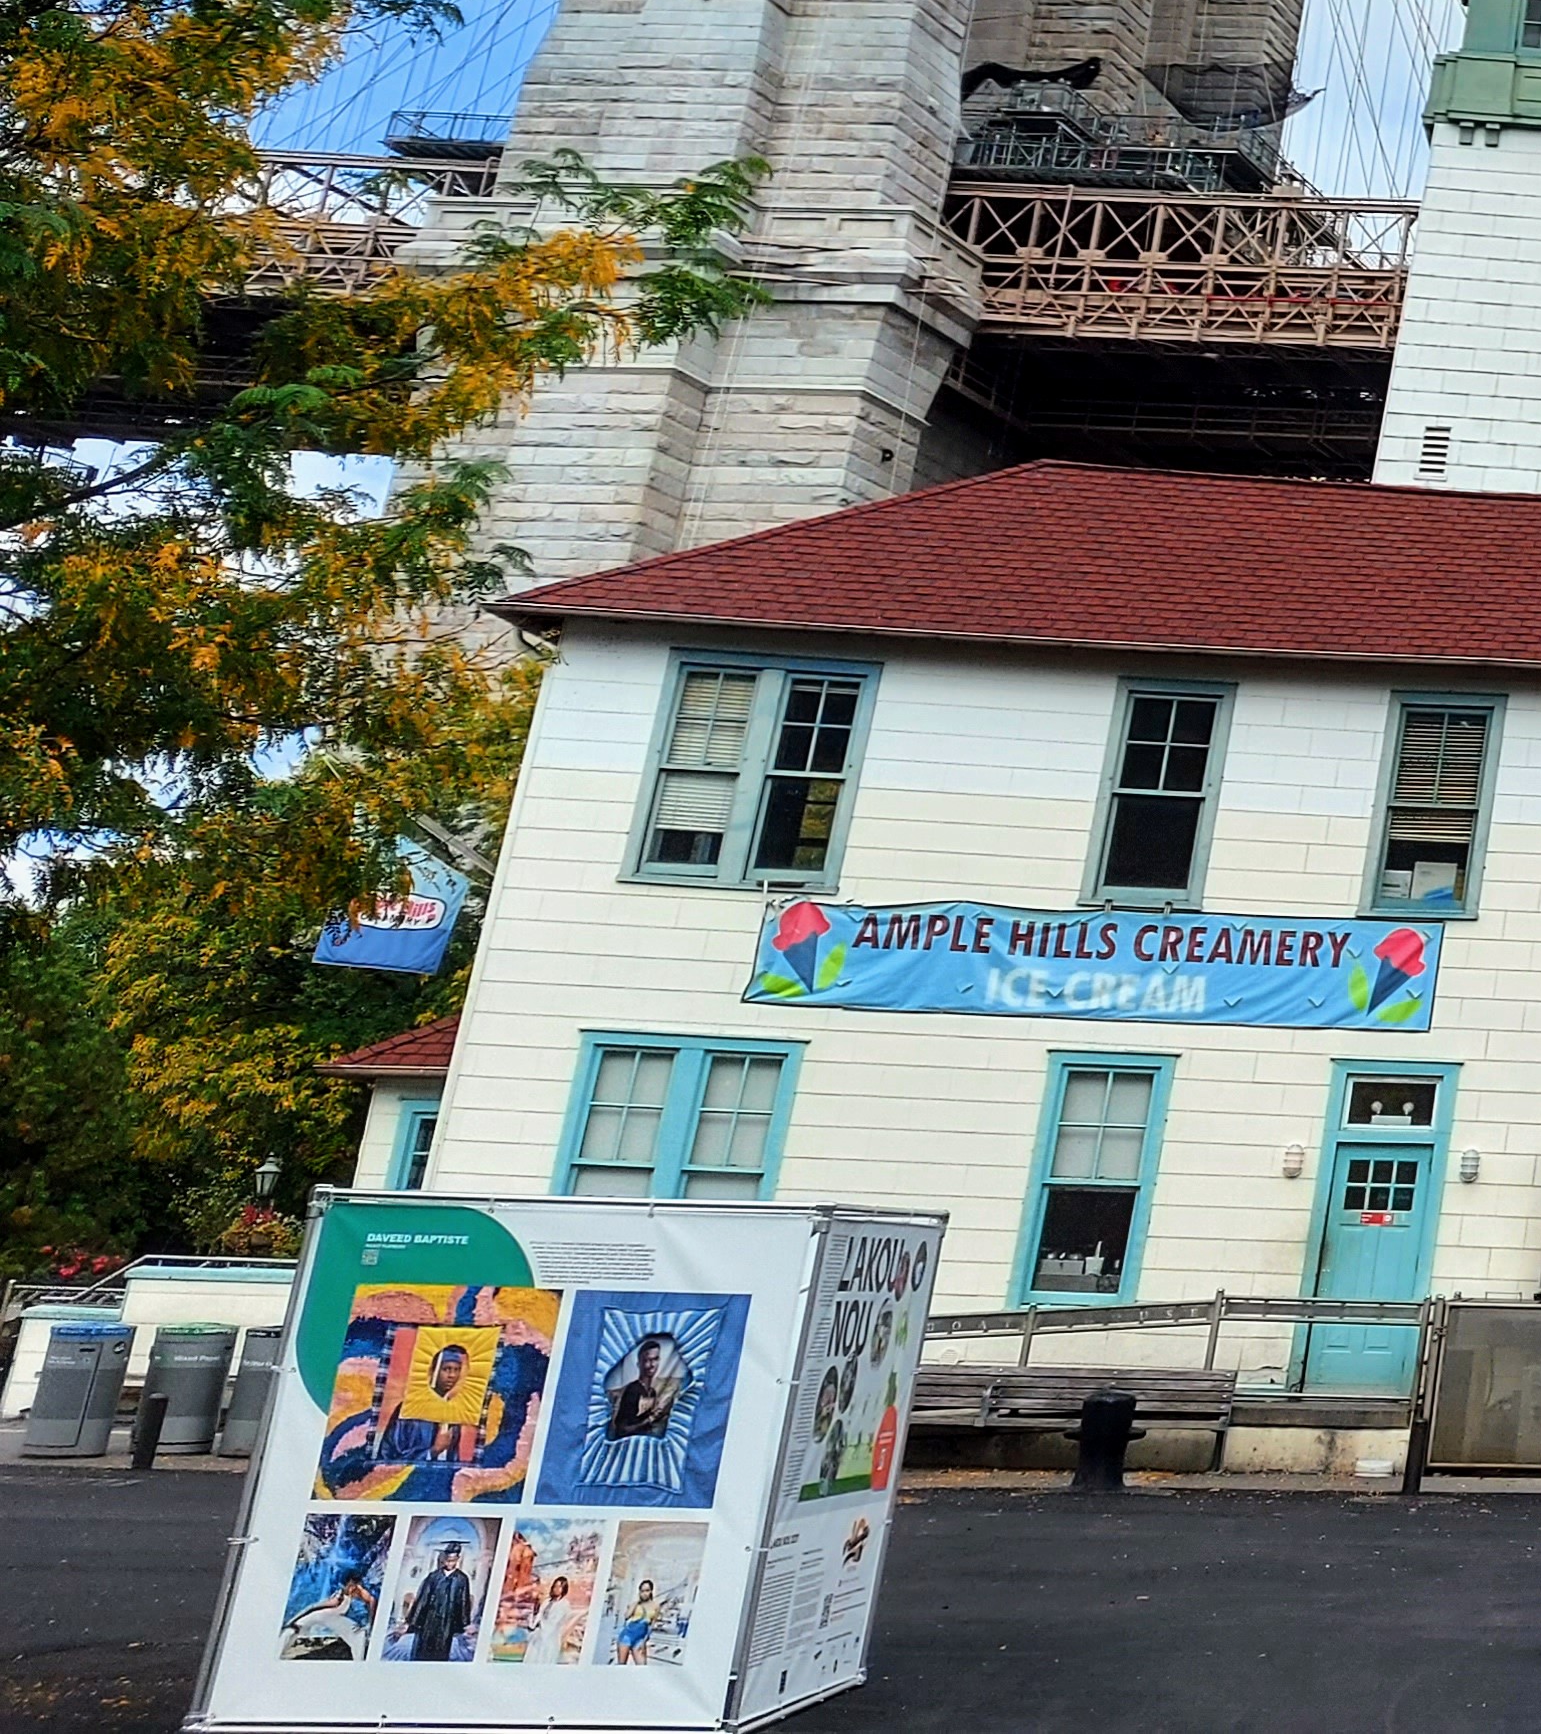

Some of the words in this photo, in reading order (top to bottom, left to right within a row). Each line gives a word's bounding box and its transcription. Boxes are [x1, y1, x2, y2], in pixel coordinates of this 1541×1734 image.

[852, 913, 994, 954] AMPLE
[1007, 920, 1118, 960] HILLS
[1133, 924, 1352, 968] CREAMERY
[984, 967, 1048, 1008] ICE
[1063, 971, 1207, 1013] CREAM
[366, 1232, 412, 1243] DAVEED
[413, 1234, 470, 1245] BAPTISTE
[837, 1236, 905, 1293] LAKOU
[826, 1299, 874, 1357] NOU
